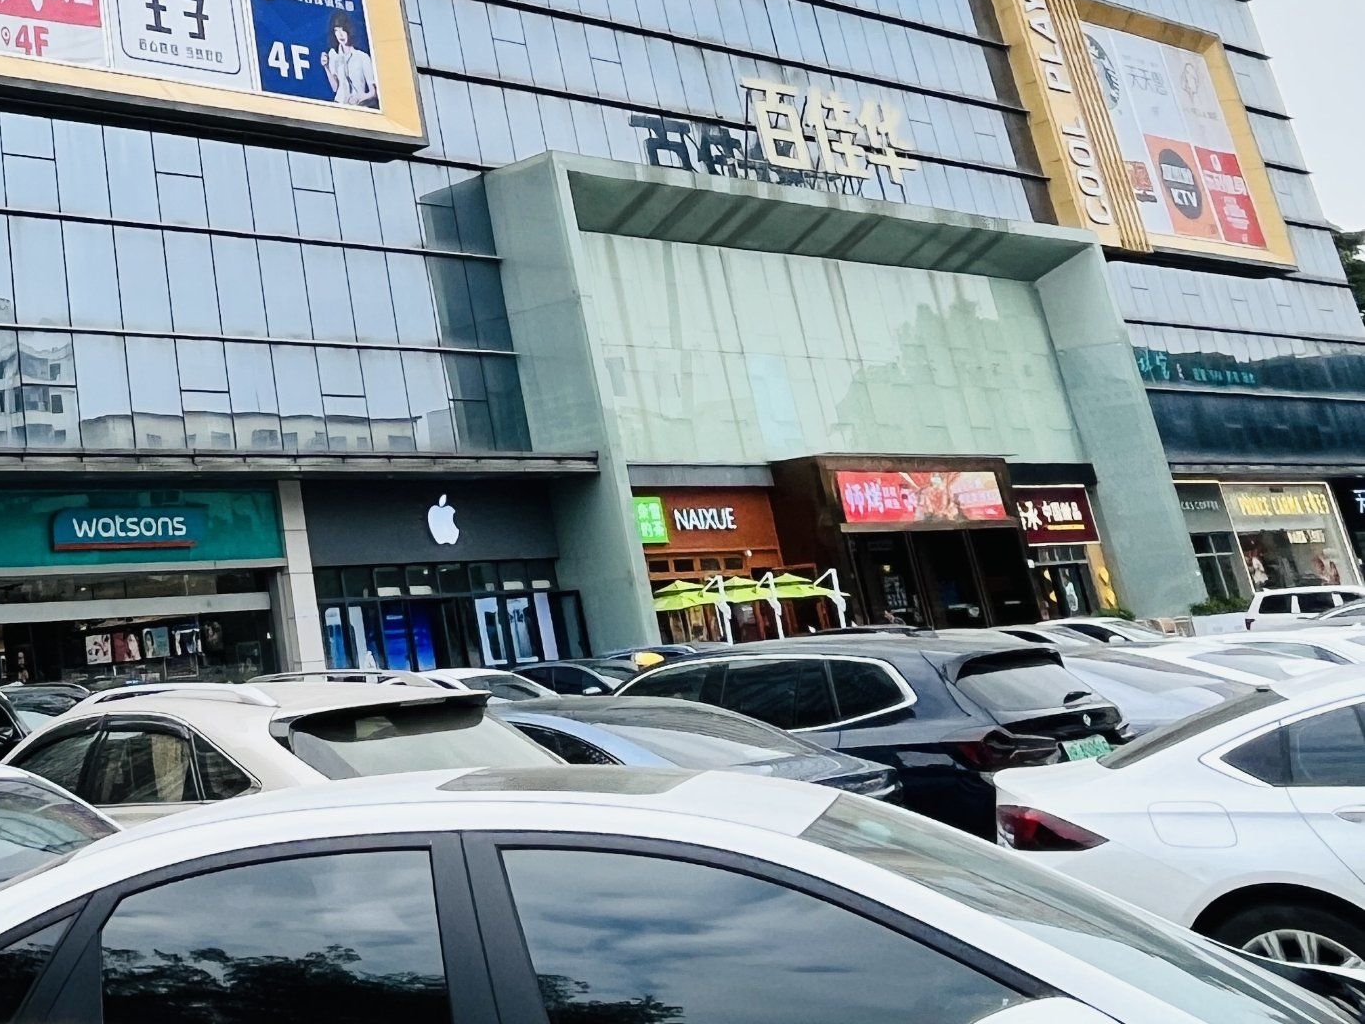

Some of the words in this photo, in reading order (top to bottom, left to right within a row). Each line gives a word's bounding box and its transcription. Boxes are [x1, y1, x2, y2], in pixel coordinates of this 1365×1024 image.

[15, 24, 49, 57] 4F
[267, 40, 311, 81] 4F
[1062, 118, 1112, 226] COOL
[1170, 187, 1198, 208] KTV
[72, 514, 187, 538] watsons
[673, 507, 738, 531] NAIXUE
